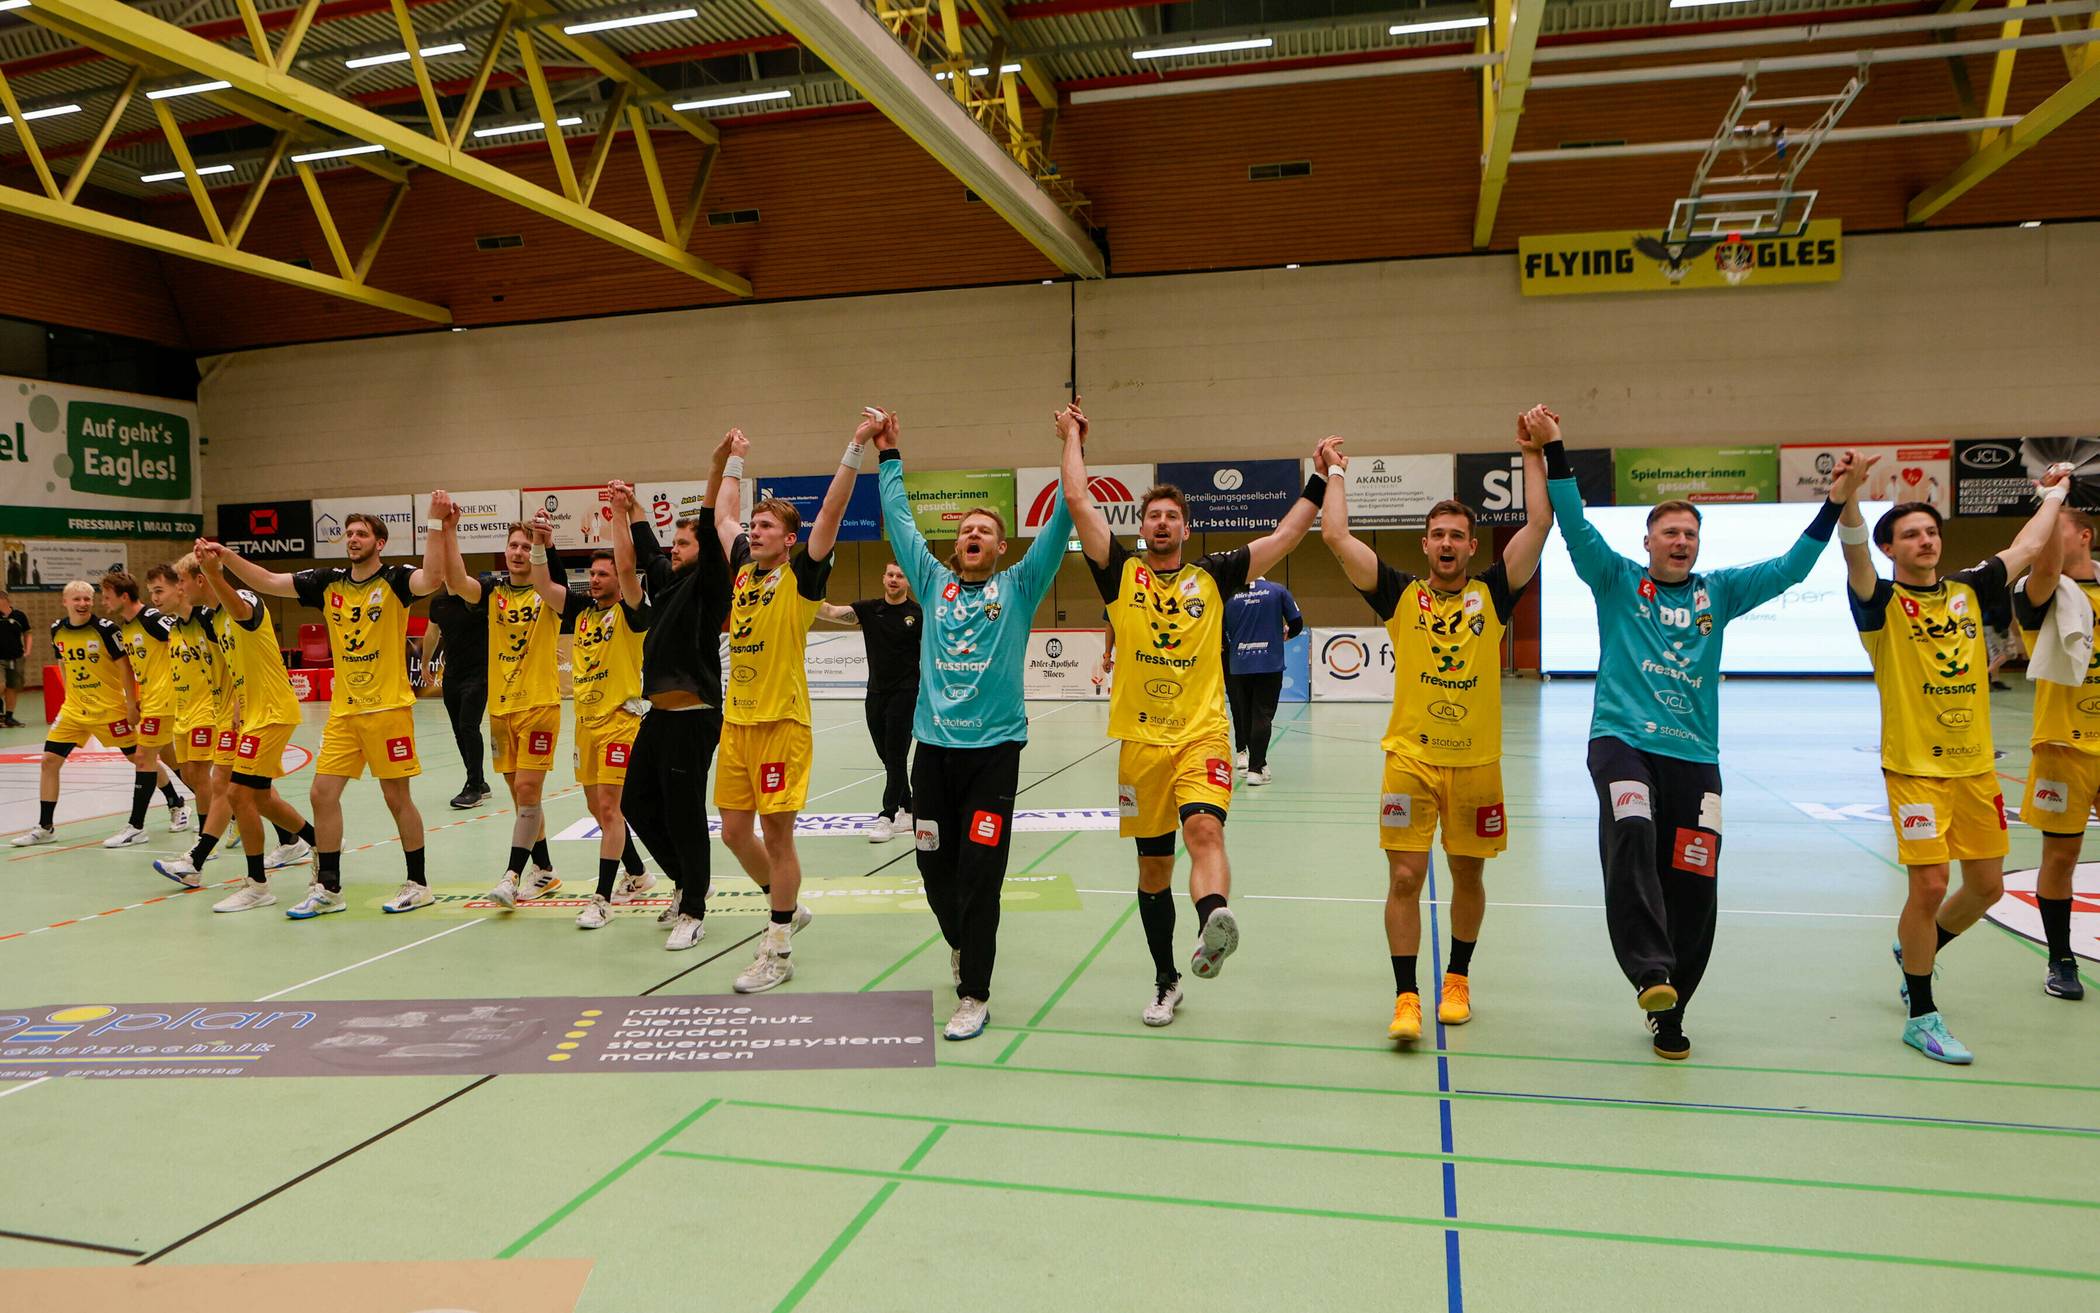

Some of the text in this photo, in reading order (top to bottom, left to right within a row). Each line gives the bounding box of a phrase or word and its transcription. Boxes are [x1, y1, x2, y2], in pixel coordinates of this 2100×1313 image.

[1525, 249, 1634, 278] FLYING
[82, 417, 116, 439] Auf
[1973, 449, 2001, 463] JCL
[84, 447, 177, 487] Eagles!
[1356, 475, 1403, 484] AKANDUS
[1631, 467, 1746, 483] Spielmacher:innen
[1184, 491, 1287, 503] Beteiligungsgesellschaft
[478, 503, 497, 513] POST
[68, 518, 135, 532] FRESSNAPF
[143, 521, 172, 532] MAXI
[463, 522, 479, 532] DES
[859, 519, 877, 529] Weg.
[1186, 517, 1281, 529] .kr-beteiligung.
[350, 606, 361, 623] 3
[507, 606, 532, 623] 33
[1431, 609, 1462, 635] 27
[67, 648, 86, 661] 19
[1135, 650, 1198, 670] fressnapf
[935, 656, 993, 673] fressnapf
[1029, 660, 1079, 669] Adler-Apotheke
[1420, 671, 1478, 691] fressnapf
[1152, 683, 1173, 695] JCL
[1664, 694, 1687, 709] JCL
[1437, 704, 1459, 718] JCL
[1949, 713, 1970, 723] JCL
[943, 718, 983, 728] station 3
[1150, 714, 1186, 727] station 3
[1431, 736, 1472, 747] station 3
[627, 1006, 752, 1017] raffstore
[88, 1008, 317, 1036] plan
[622, 1014, 814, 1028] blendschutz
[613, 1027, 748, 1039] rolladen
[606, 1034, 925, 1051] steuerungssysteme
[599, 1050, 754, 1062] markisen
